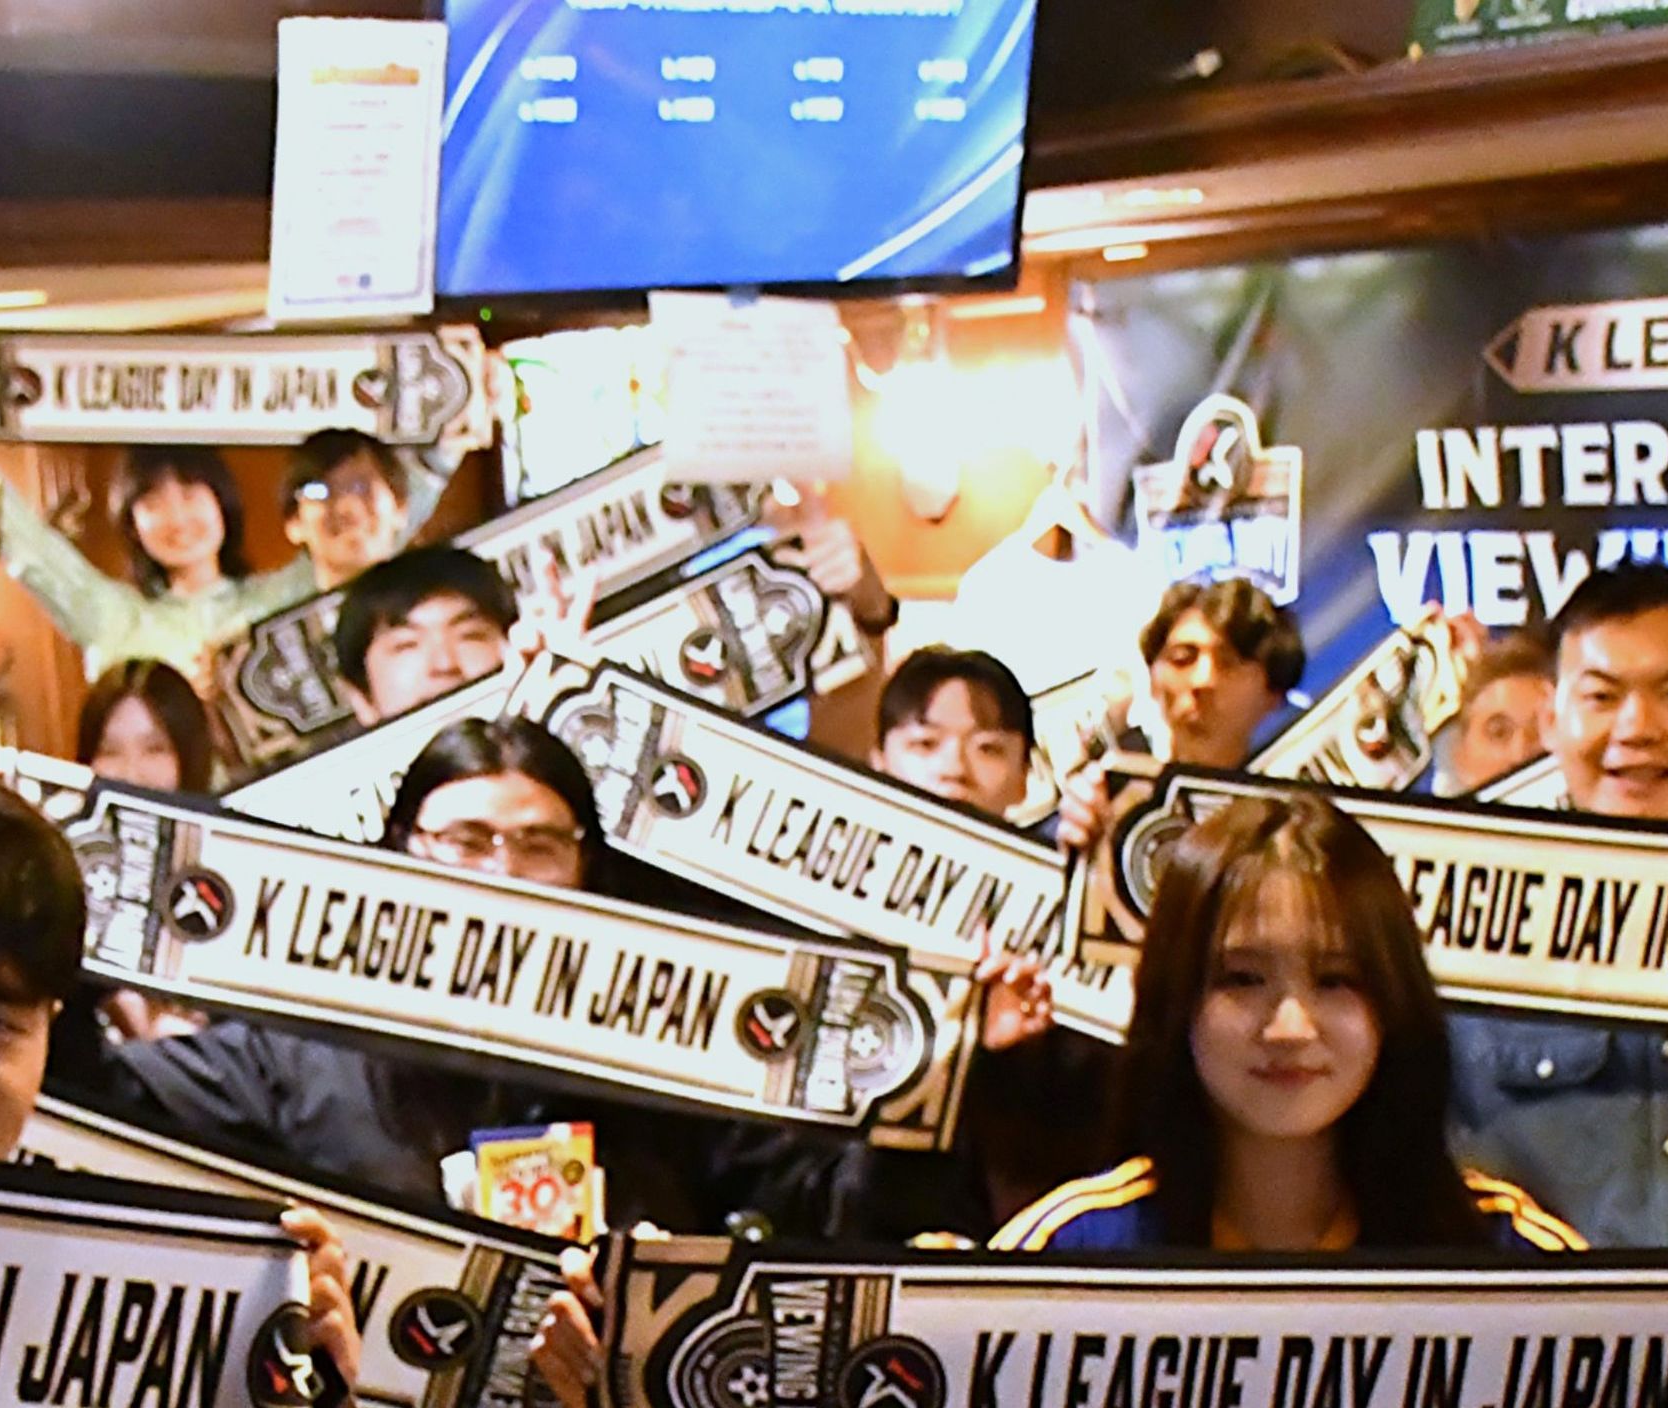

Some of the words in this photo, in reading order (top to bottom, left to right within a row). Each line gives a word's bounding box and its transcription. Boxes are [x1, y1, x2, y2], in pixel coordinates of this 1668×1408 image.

[1544, 320, 1588, 376] K
[710, 773, 753, 846] K
[746, 789, 892, 900] LEAGUE
[884, 843, 967, 928] DAY
[244, 876, 287, 960] K
[288, 884, 450, 990] LEAGUE
[448, 917, 535, 1007] DAY
[535, 935, 589, 1021] IN
[588, 949, 729, 1052] JAPAN
[1410, 858, 1545, 956] EAGUE
[1548, 876, 1641, 968] DAY
[769, 1278, 830, 1400] VIEWING
